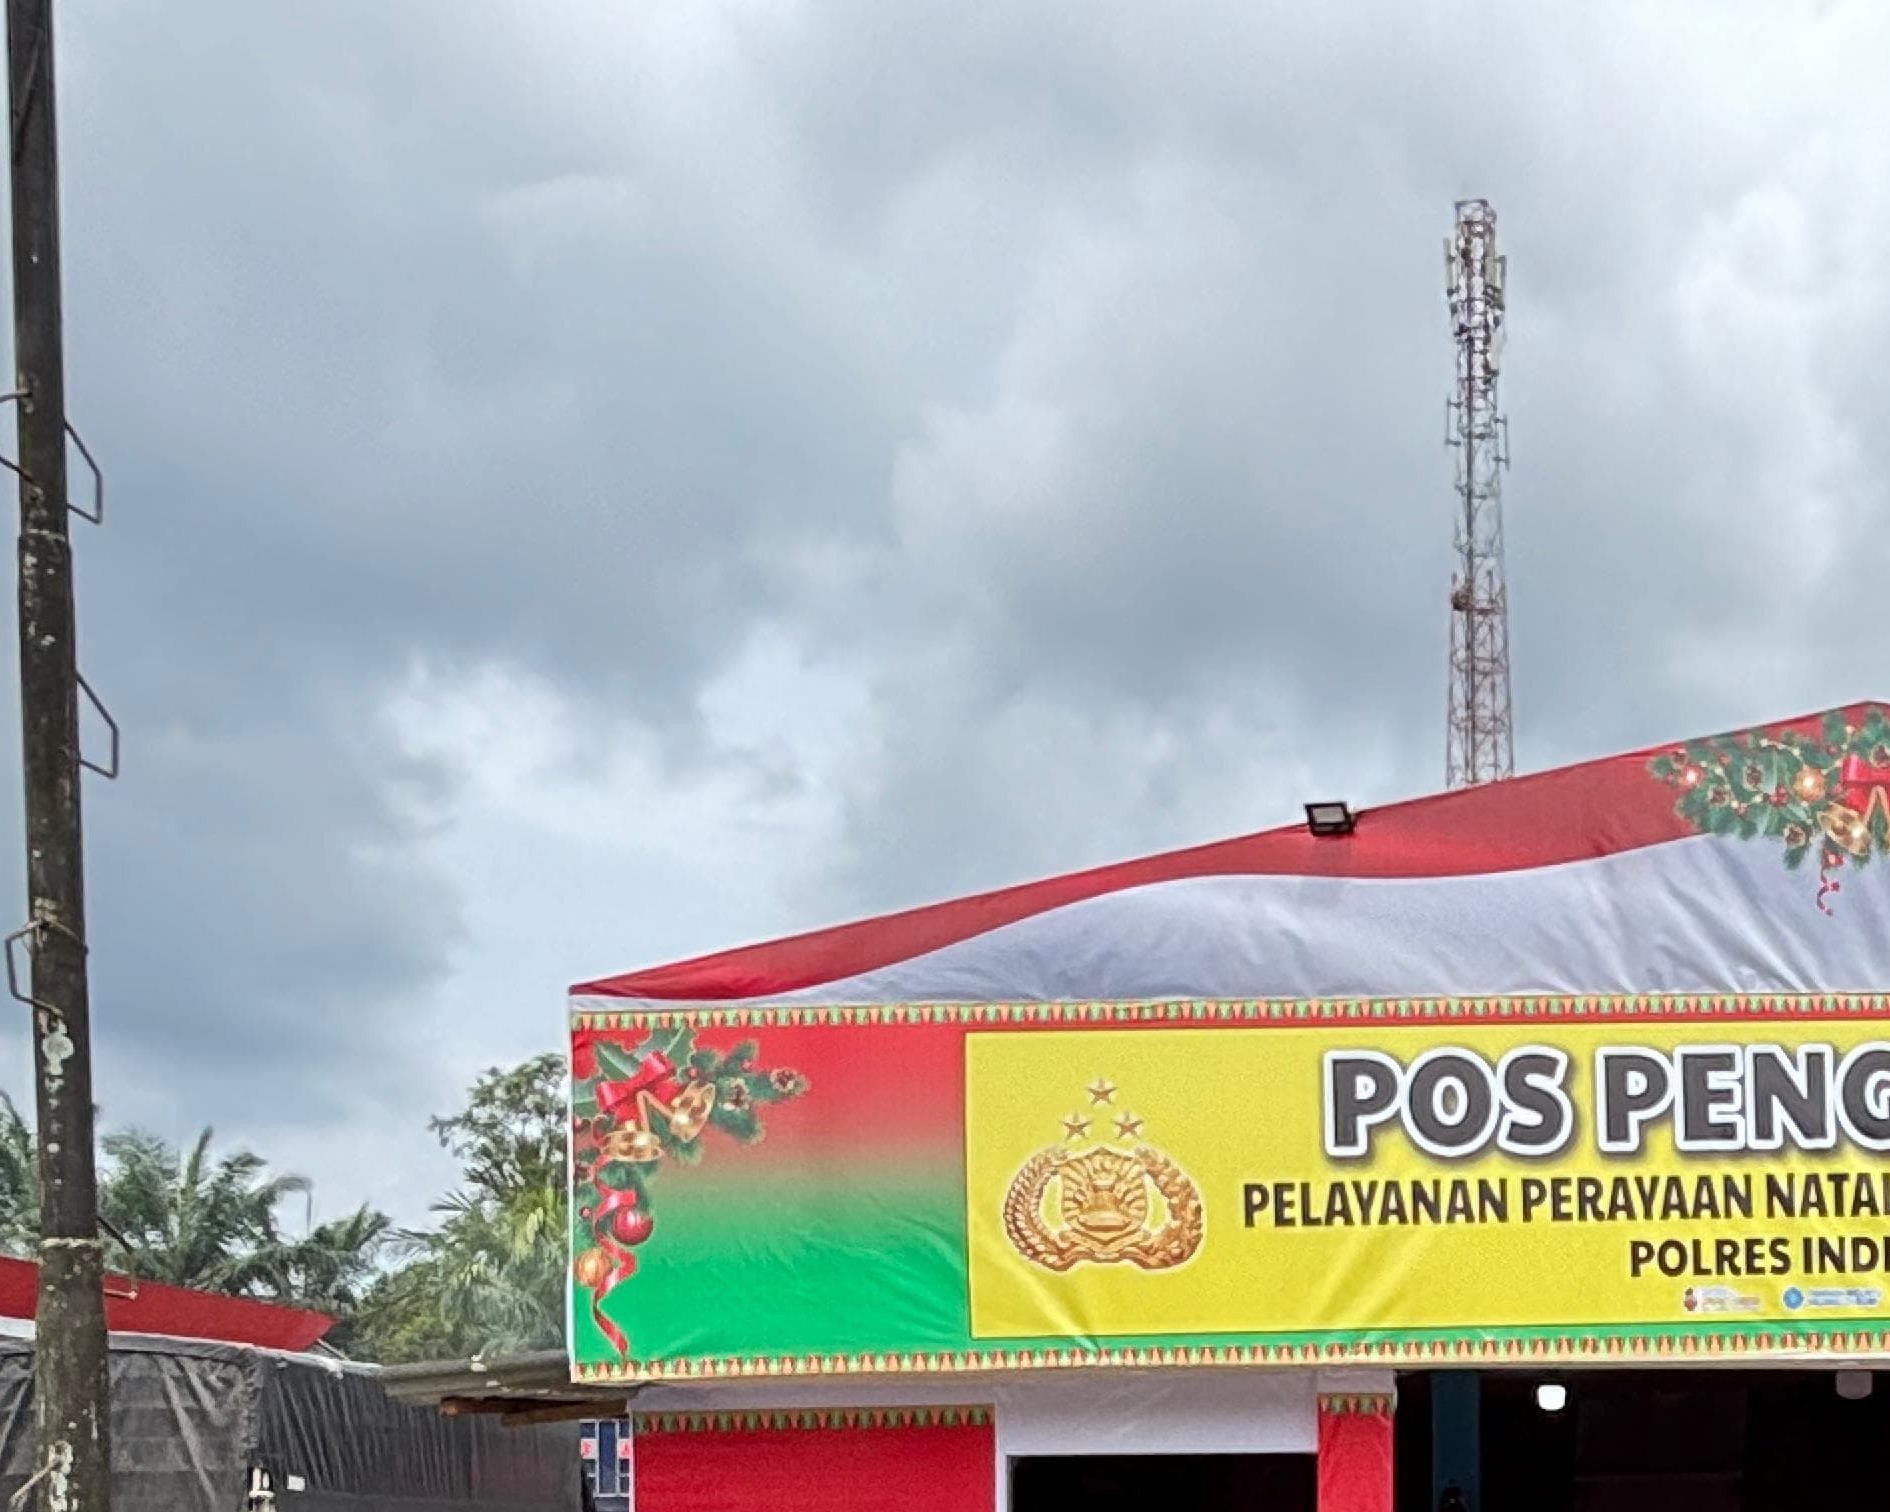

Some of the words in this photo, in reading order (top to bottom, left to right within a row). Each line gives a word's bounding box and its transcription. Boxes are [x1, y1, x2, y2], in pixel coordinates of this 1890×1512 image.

[1324, 1046, 1567, 1157] POS
[1243, 1178, 1509, 1228] PELAYANAN
[1521, 1174, 1753, 1222] PERAYAAN
[1630, 1237, 1791, 1278] POLRES
